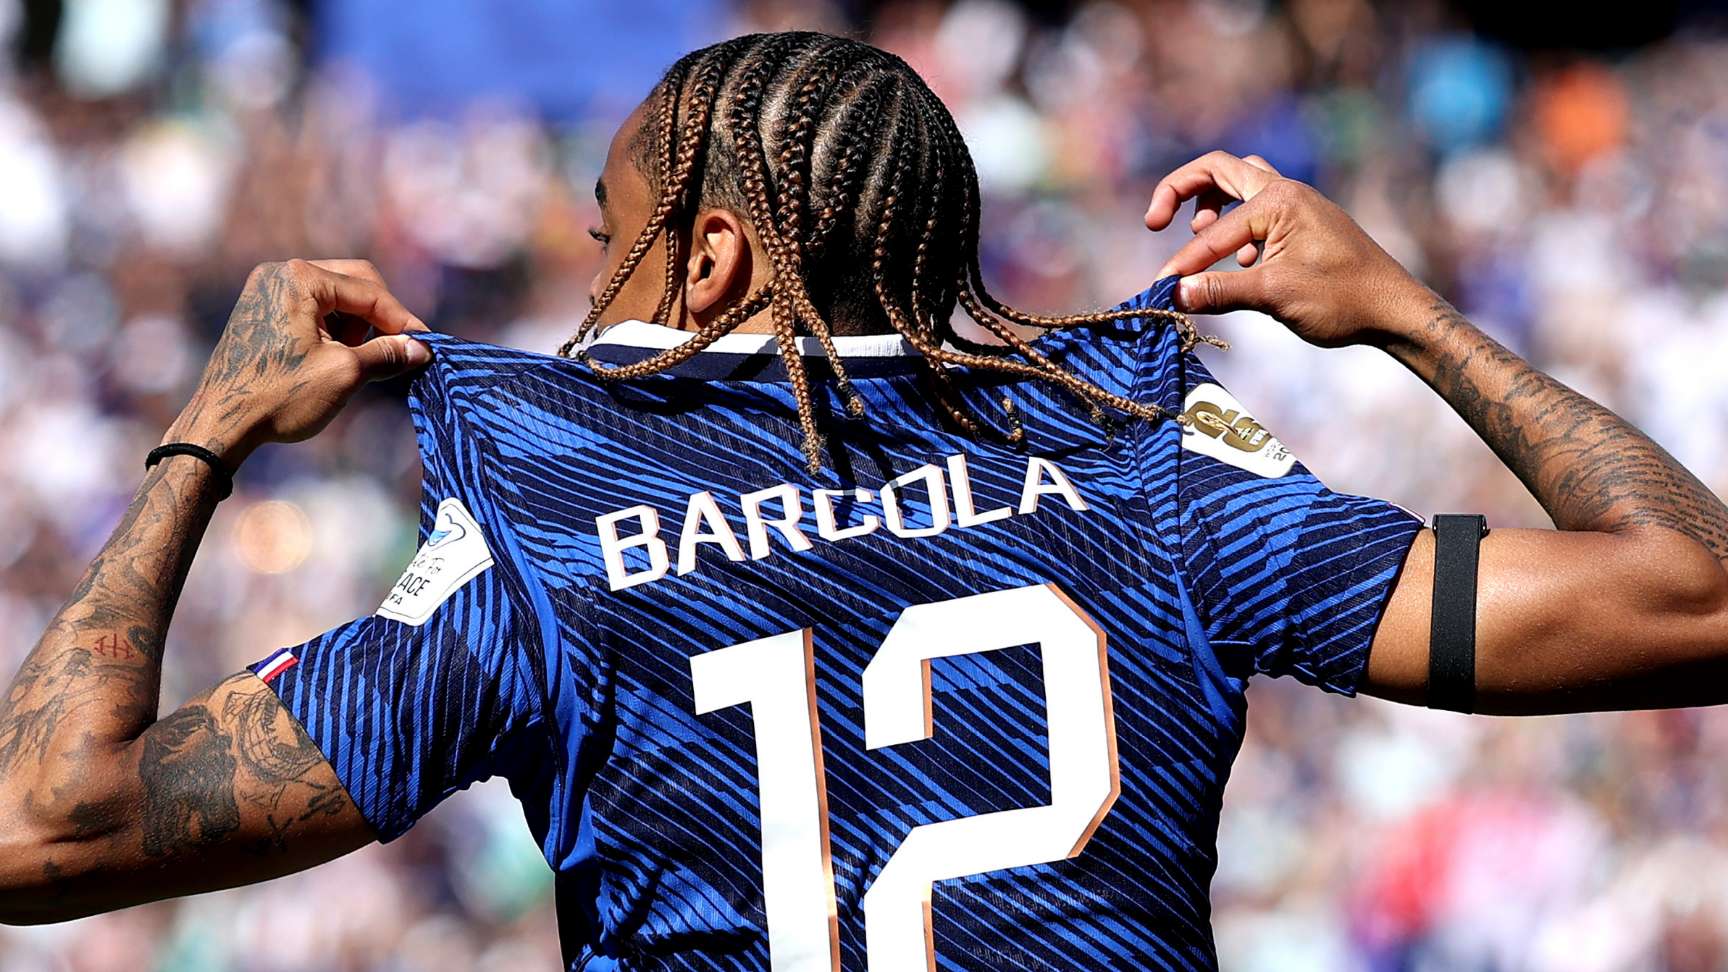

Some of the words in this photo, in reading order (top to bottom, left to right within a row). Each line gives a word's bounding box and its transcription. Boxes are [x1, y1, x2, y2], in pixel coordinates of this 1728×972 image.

[595, 453, 1089, 592] BARCOLA
[389, 593, 403, 605] FA
[397, 572, 431, 597] ACE
[689, 582, 1121, 972] 12
